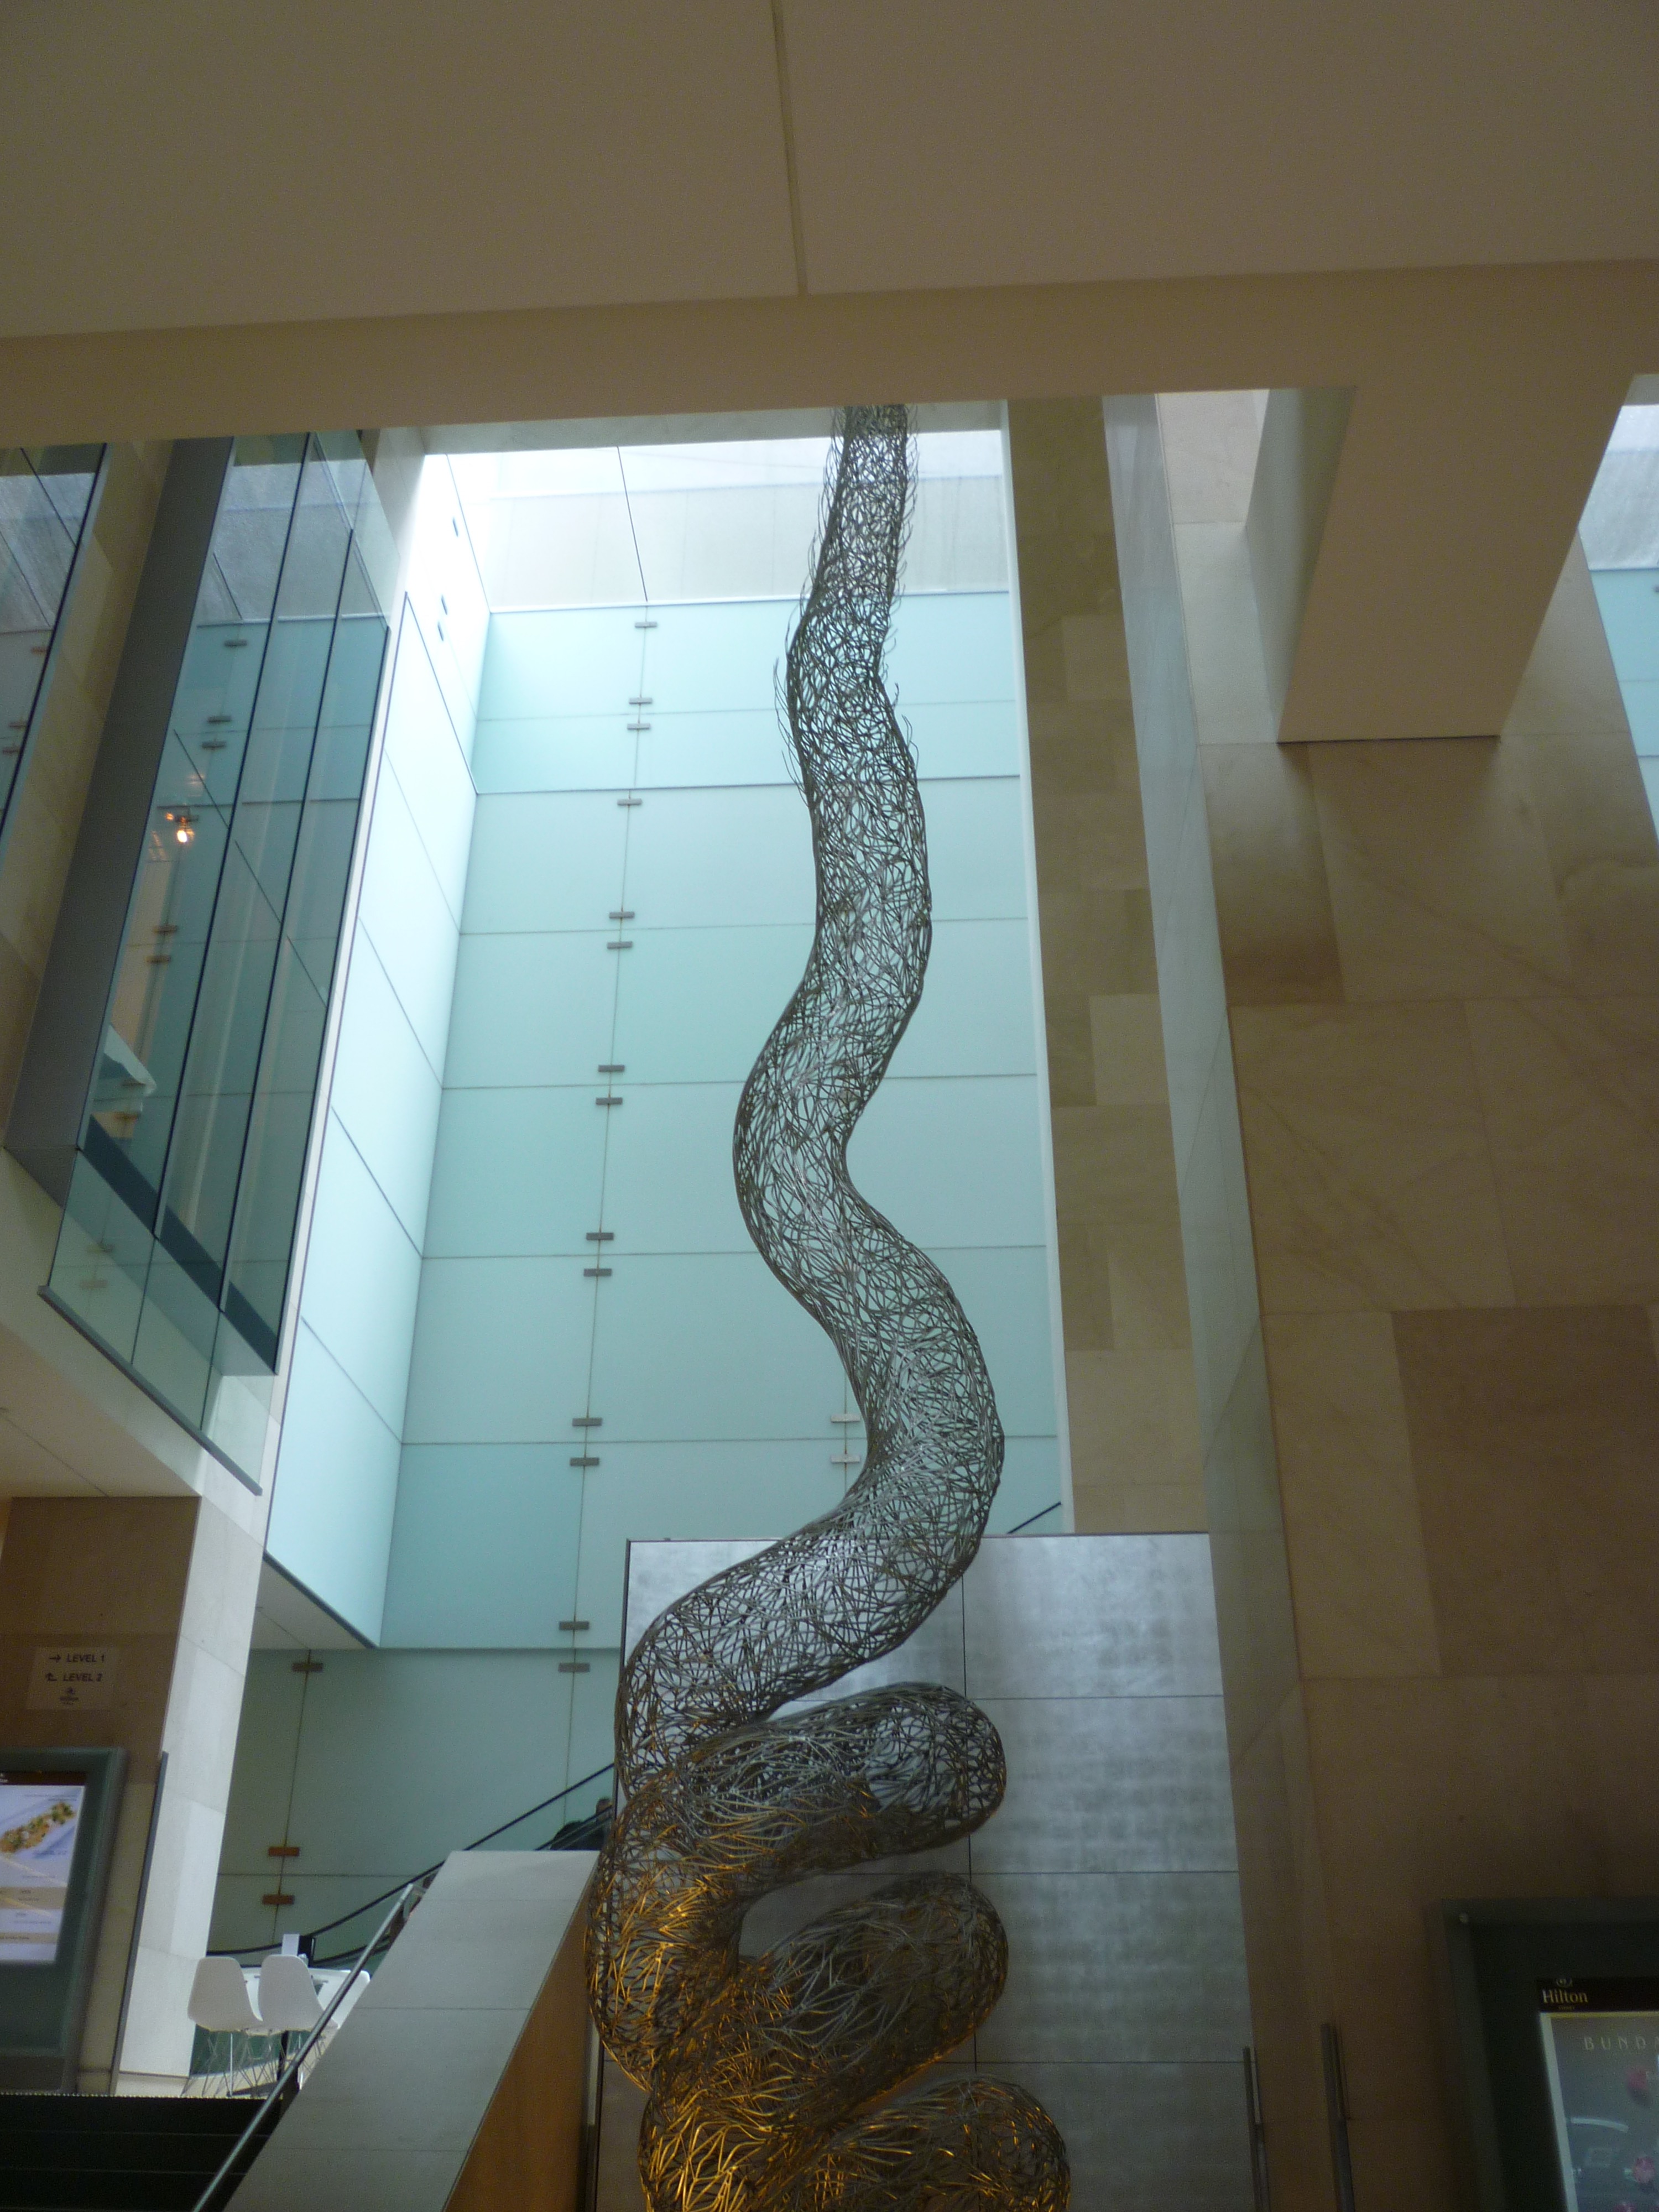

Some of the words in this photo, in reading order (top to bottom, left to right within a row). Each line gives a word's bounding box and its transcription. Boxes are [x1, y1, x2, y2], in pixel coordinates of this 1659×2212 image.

[66, 1654, 96, 1662] LEVEL
[101, 1654, 104, 1662] 1
[63, 1673, 93, 1682] LEVEL
[1542, 1989, 1588, 2003] Hilton
